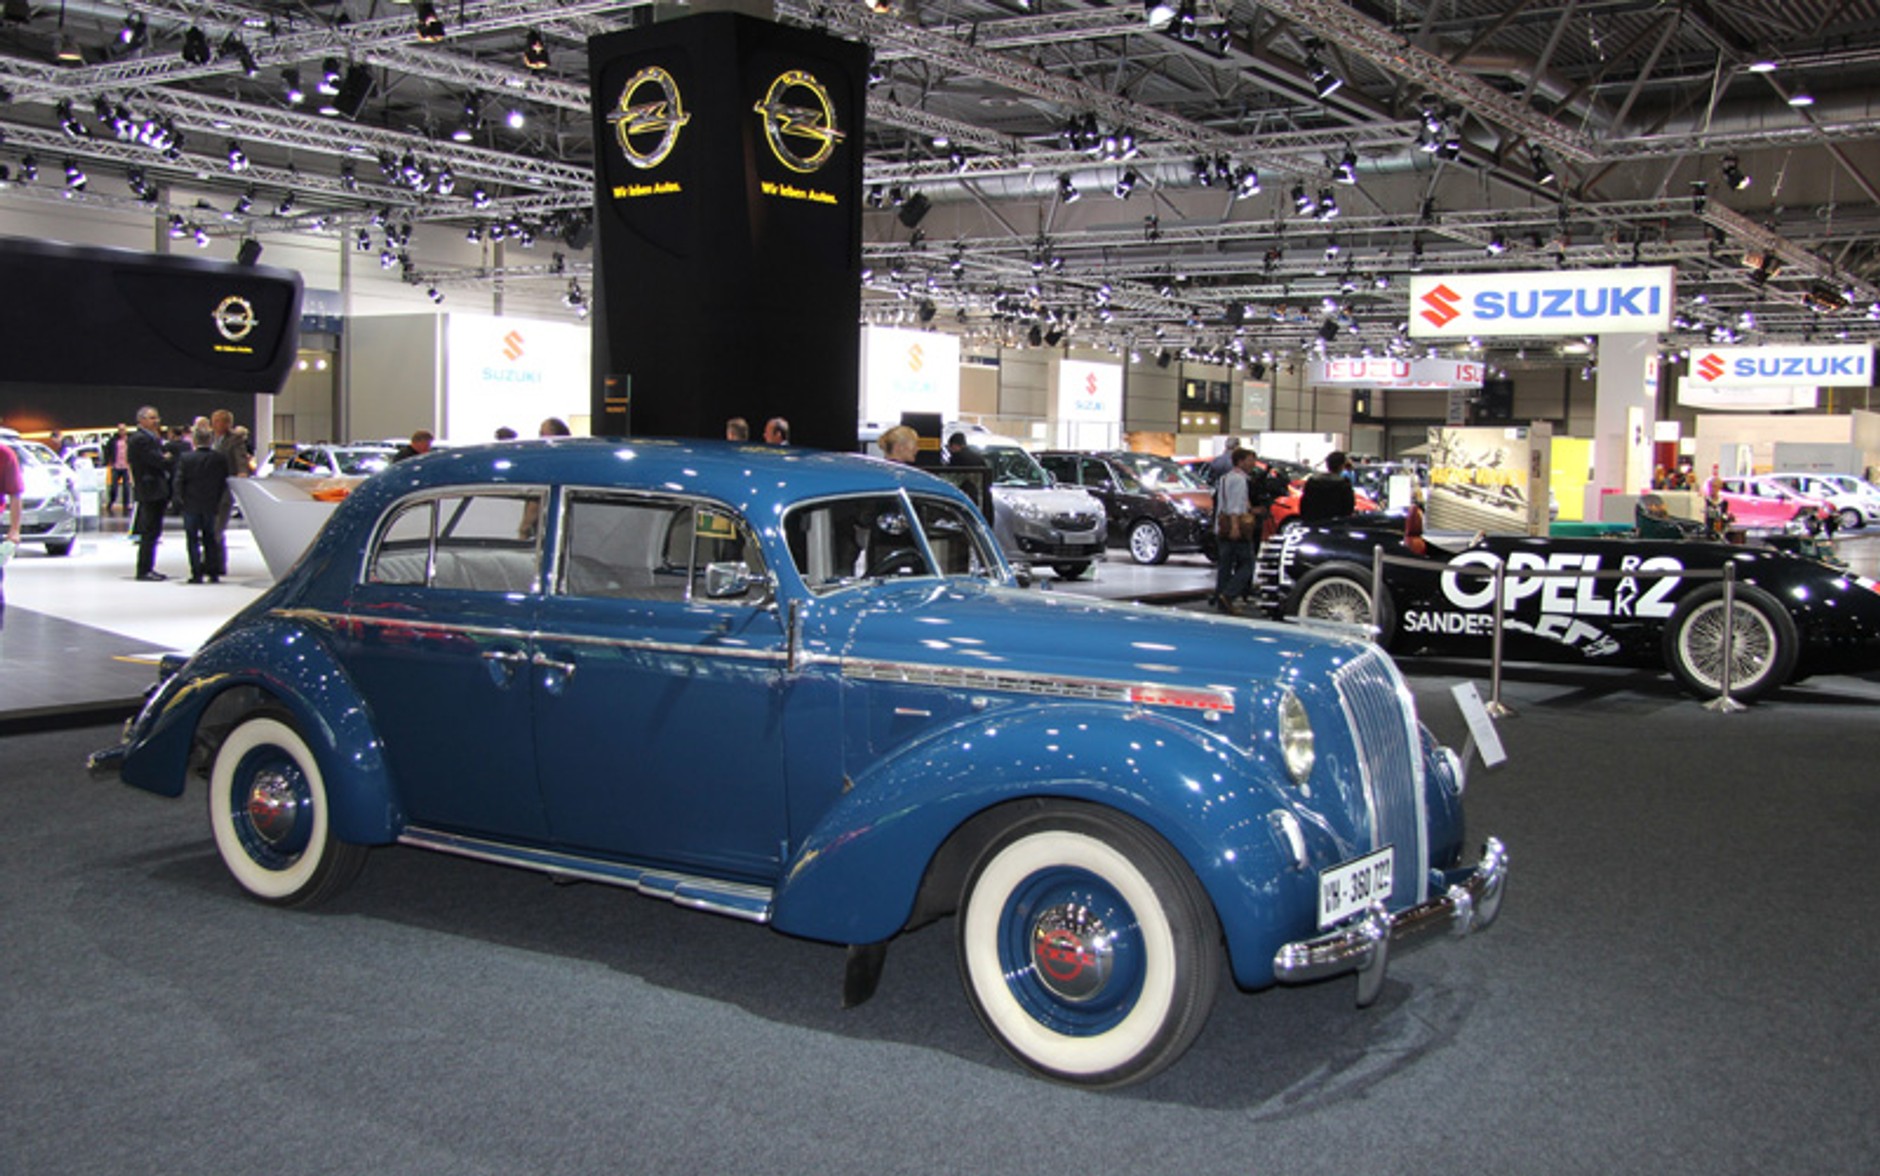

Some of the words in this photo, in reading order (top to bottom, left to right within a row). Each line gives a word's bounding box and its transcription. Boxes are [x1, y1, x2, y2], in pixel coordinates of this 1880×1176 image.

[1473, 286, 1660, 320] SUZUKI
[482, 366, 542, 383] SUZUKI
[1325, 361, 1411, 379] ISUZU
[1734, 355, 1865, 378] SUZUKI
[1441, 550, 1611, 616] OPEL
[1635, 556, 1684, 618] 2
